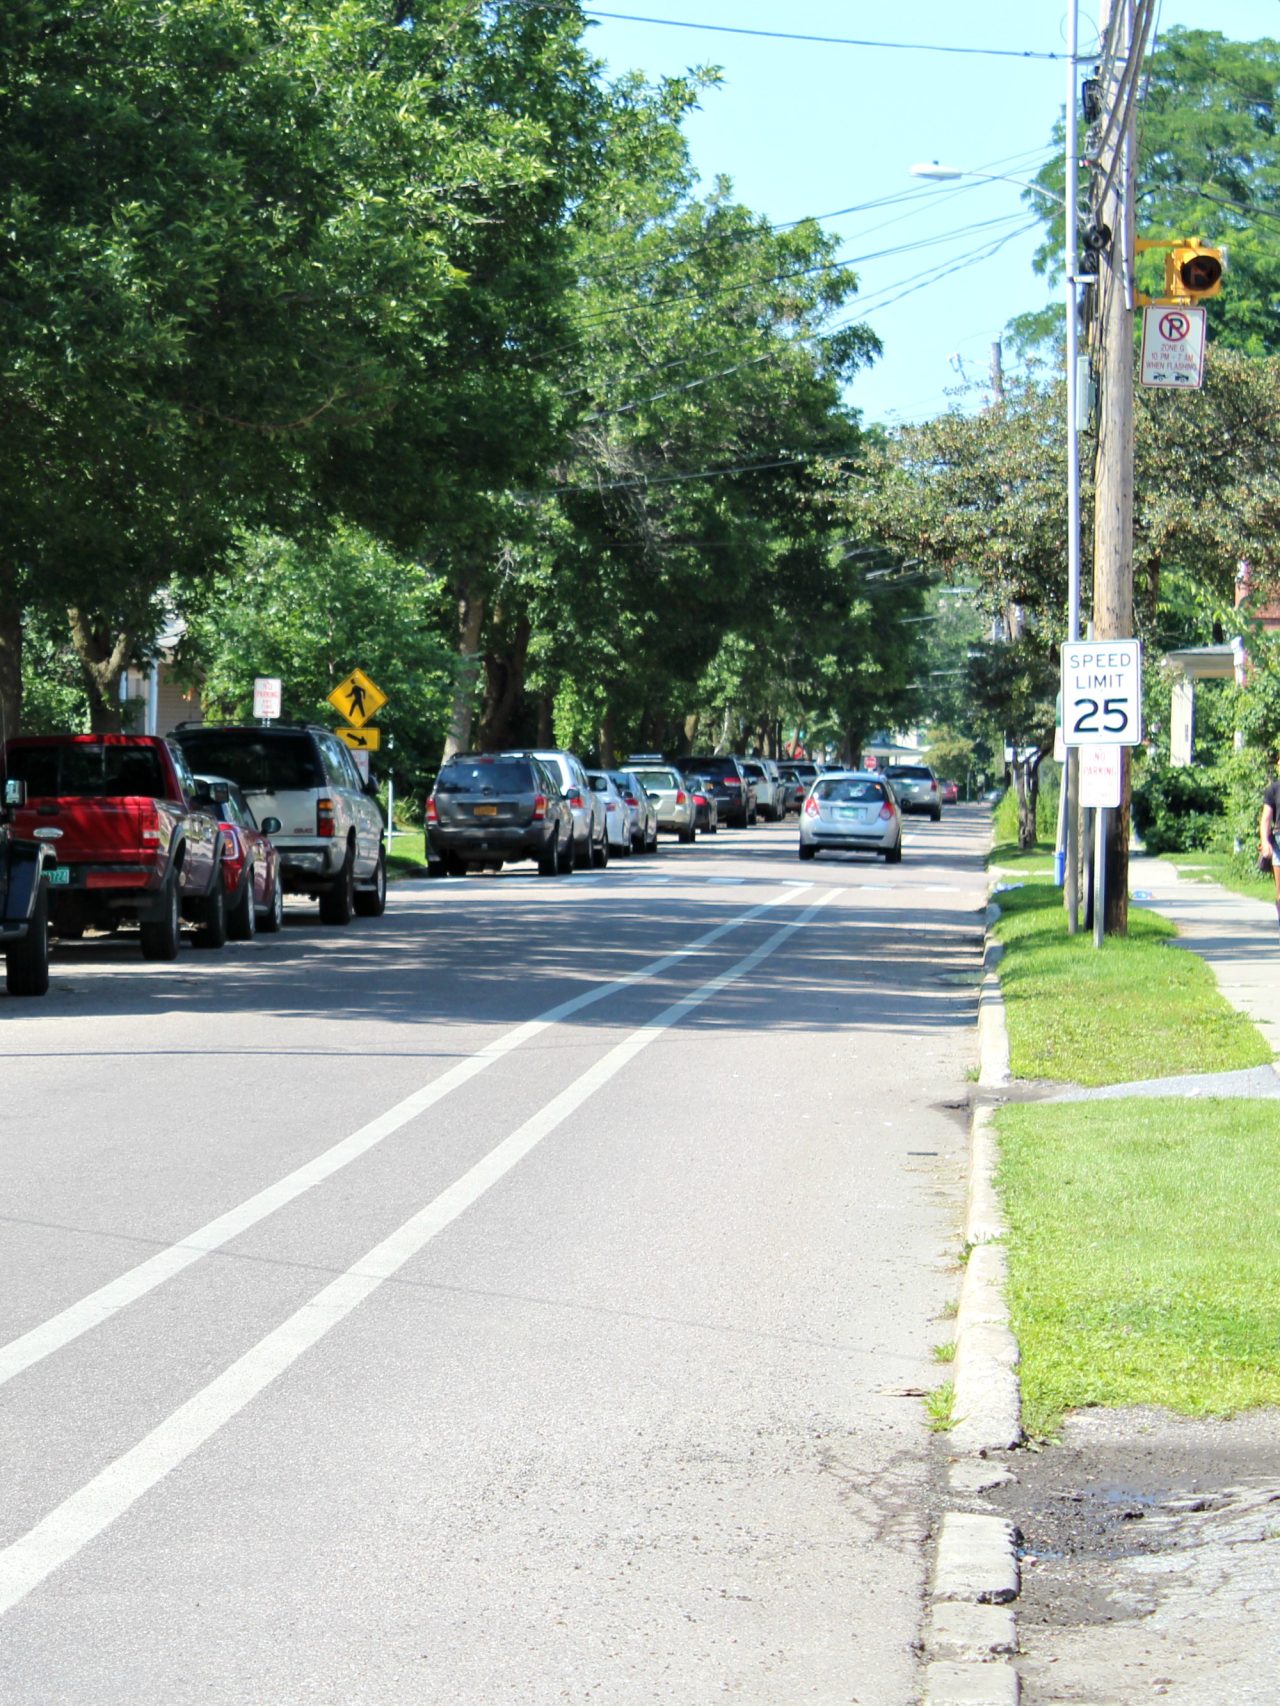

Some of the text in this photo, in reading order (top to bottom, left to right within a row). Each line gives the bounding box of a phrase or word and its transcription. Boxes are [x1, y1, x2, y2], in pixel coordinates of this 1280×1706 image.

[1161, 344, 1177, 352] ZONE
[1152, 352, 1158, 360] 10
[1160, 352, 1170, 361] PM
[1185, 353, 1194, 361] AM
[1146, 361, 1197, 370] WHEN FLASHING
[1070, 653, 1131, 669] SPEED
[1076, 673, 1124, 690] LIMIT
[1073, 698, 1129, 734] 25
[1094, 751, 1106, 761] NO
[1083, 766, 1117, 776] PARKING
